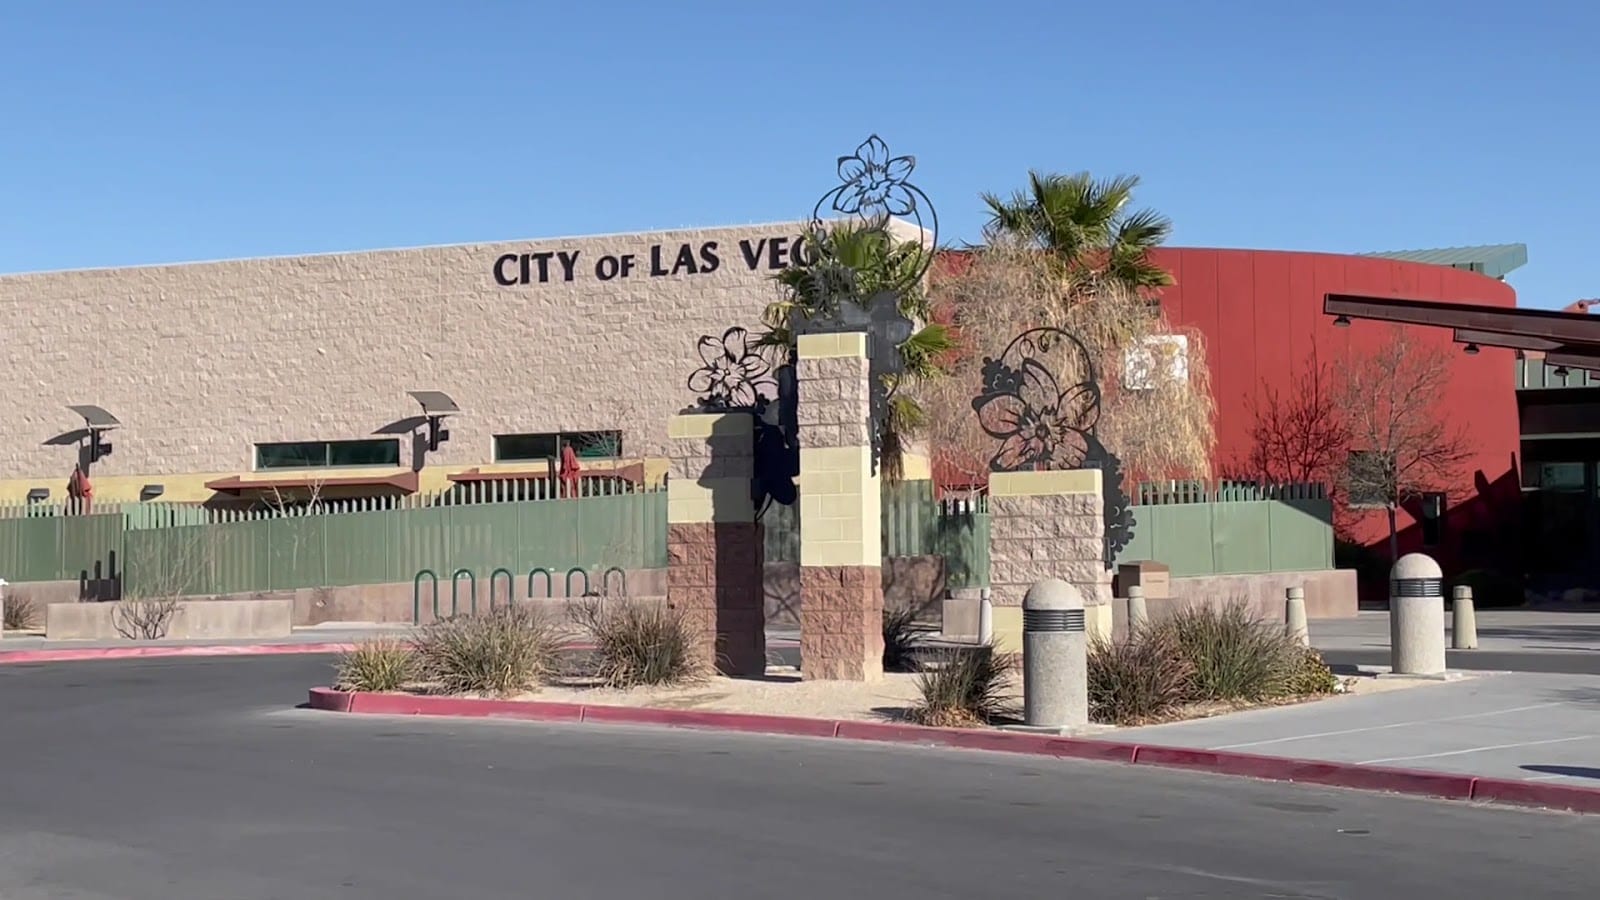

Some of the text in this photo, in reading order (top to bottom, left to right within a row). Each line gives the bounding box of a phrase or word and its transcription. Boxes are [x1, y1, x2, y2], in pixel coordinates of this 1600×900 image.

[494, 250, 580, 286] CITY
[596, 255, 635, 281] OF
[650, 241, 718, 276] LAS
